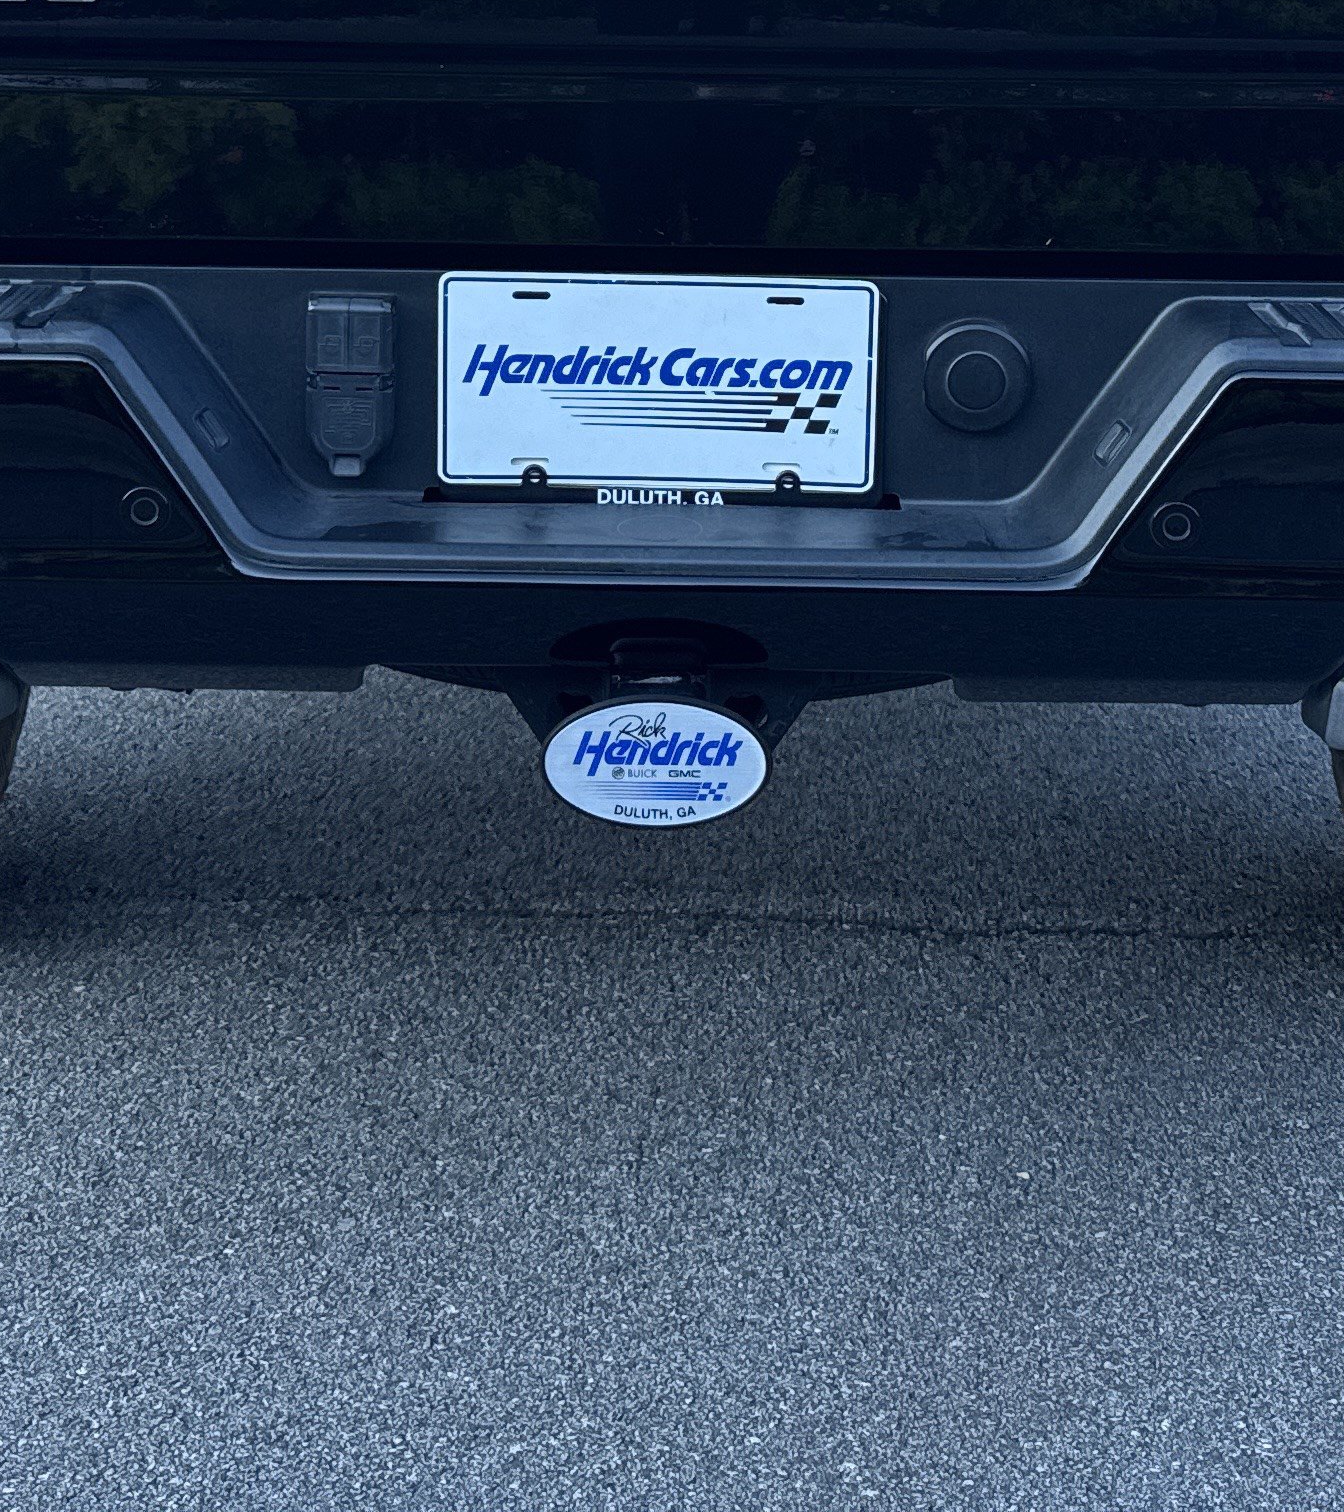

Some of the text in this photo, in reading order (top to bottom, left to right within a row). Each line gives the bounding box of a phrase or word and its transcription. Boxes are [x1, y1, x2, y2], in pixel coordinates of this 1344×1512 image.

[694, 491, 724, 505] GA
[608, 712, 667, 746] Rick
[572, 730, 744, 777] Hendrick
[627, 769, 702, 778] BUICK GMC
[613, 804, 697, 821] DULUTH, GA
